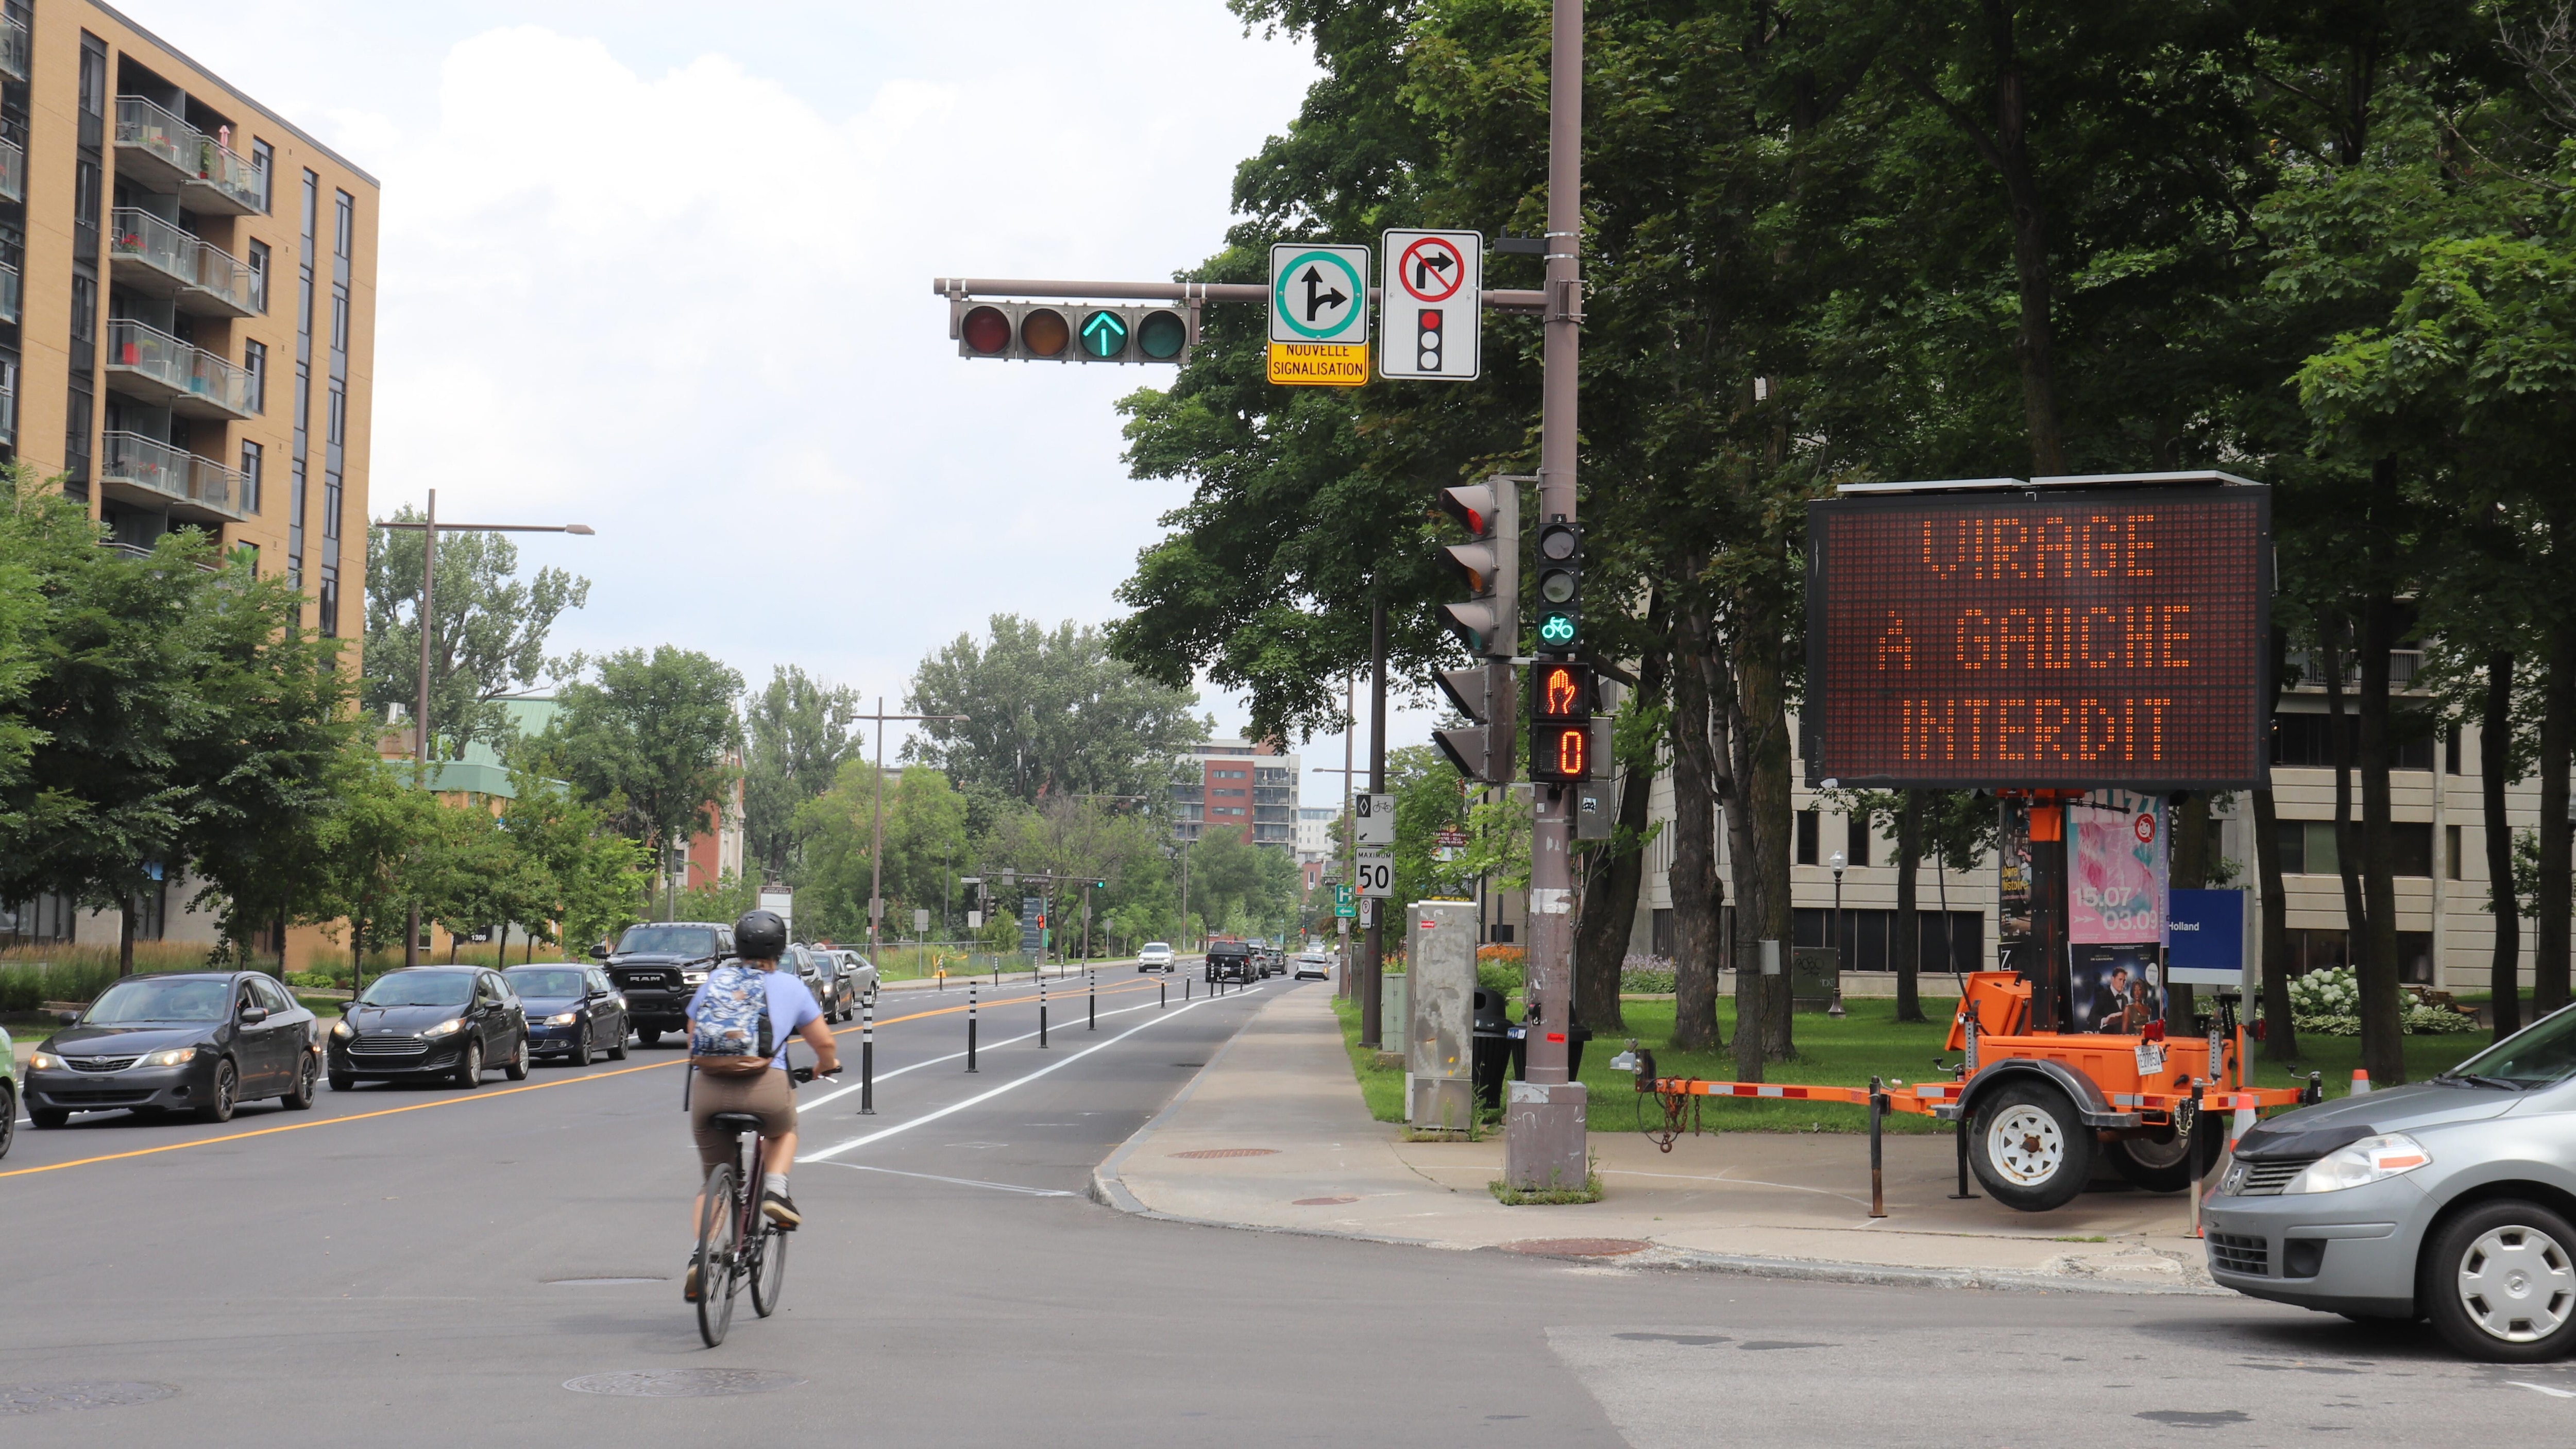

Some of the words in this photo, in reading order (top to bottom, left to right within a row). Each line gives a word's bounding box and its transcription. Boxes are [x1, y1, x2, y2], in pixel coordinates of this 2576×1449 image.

[1286, 345, 1350, 357] NOUVELLE
[1273, 361, 1363, 376] SIGNALISATION
[1923, 515, 2154, 579] VIRAGE
[1957, 605, 2190, 670] GAUCHE
[1903, 698, 2171, 761] INTERDIT
[1359, 864, 1389, 890] 50
[2072, 887, 2131, 907] 15.07
[2103, 910, 2158, 930] 03.09
[2169, 921, 2199, 931] Holland
